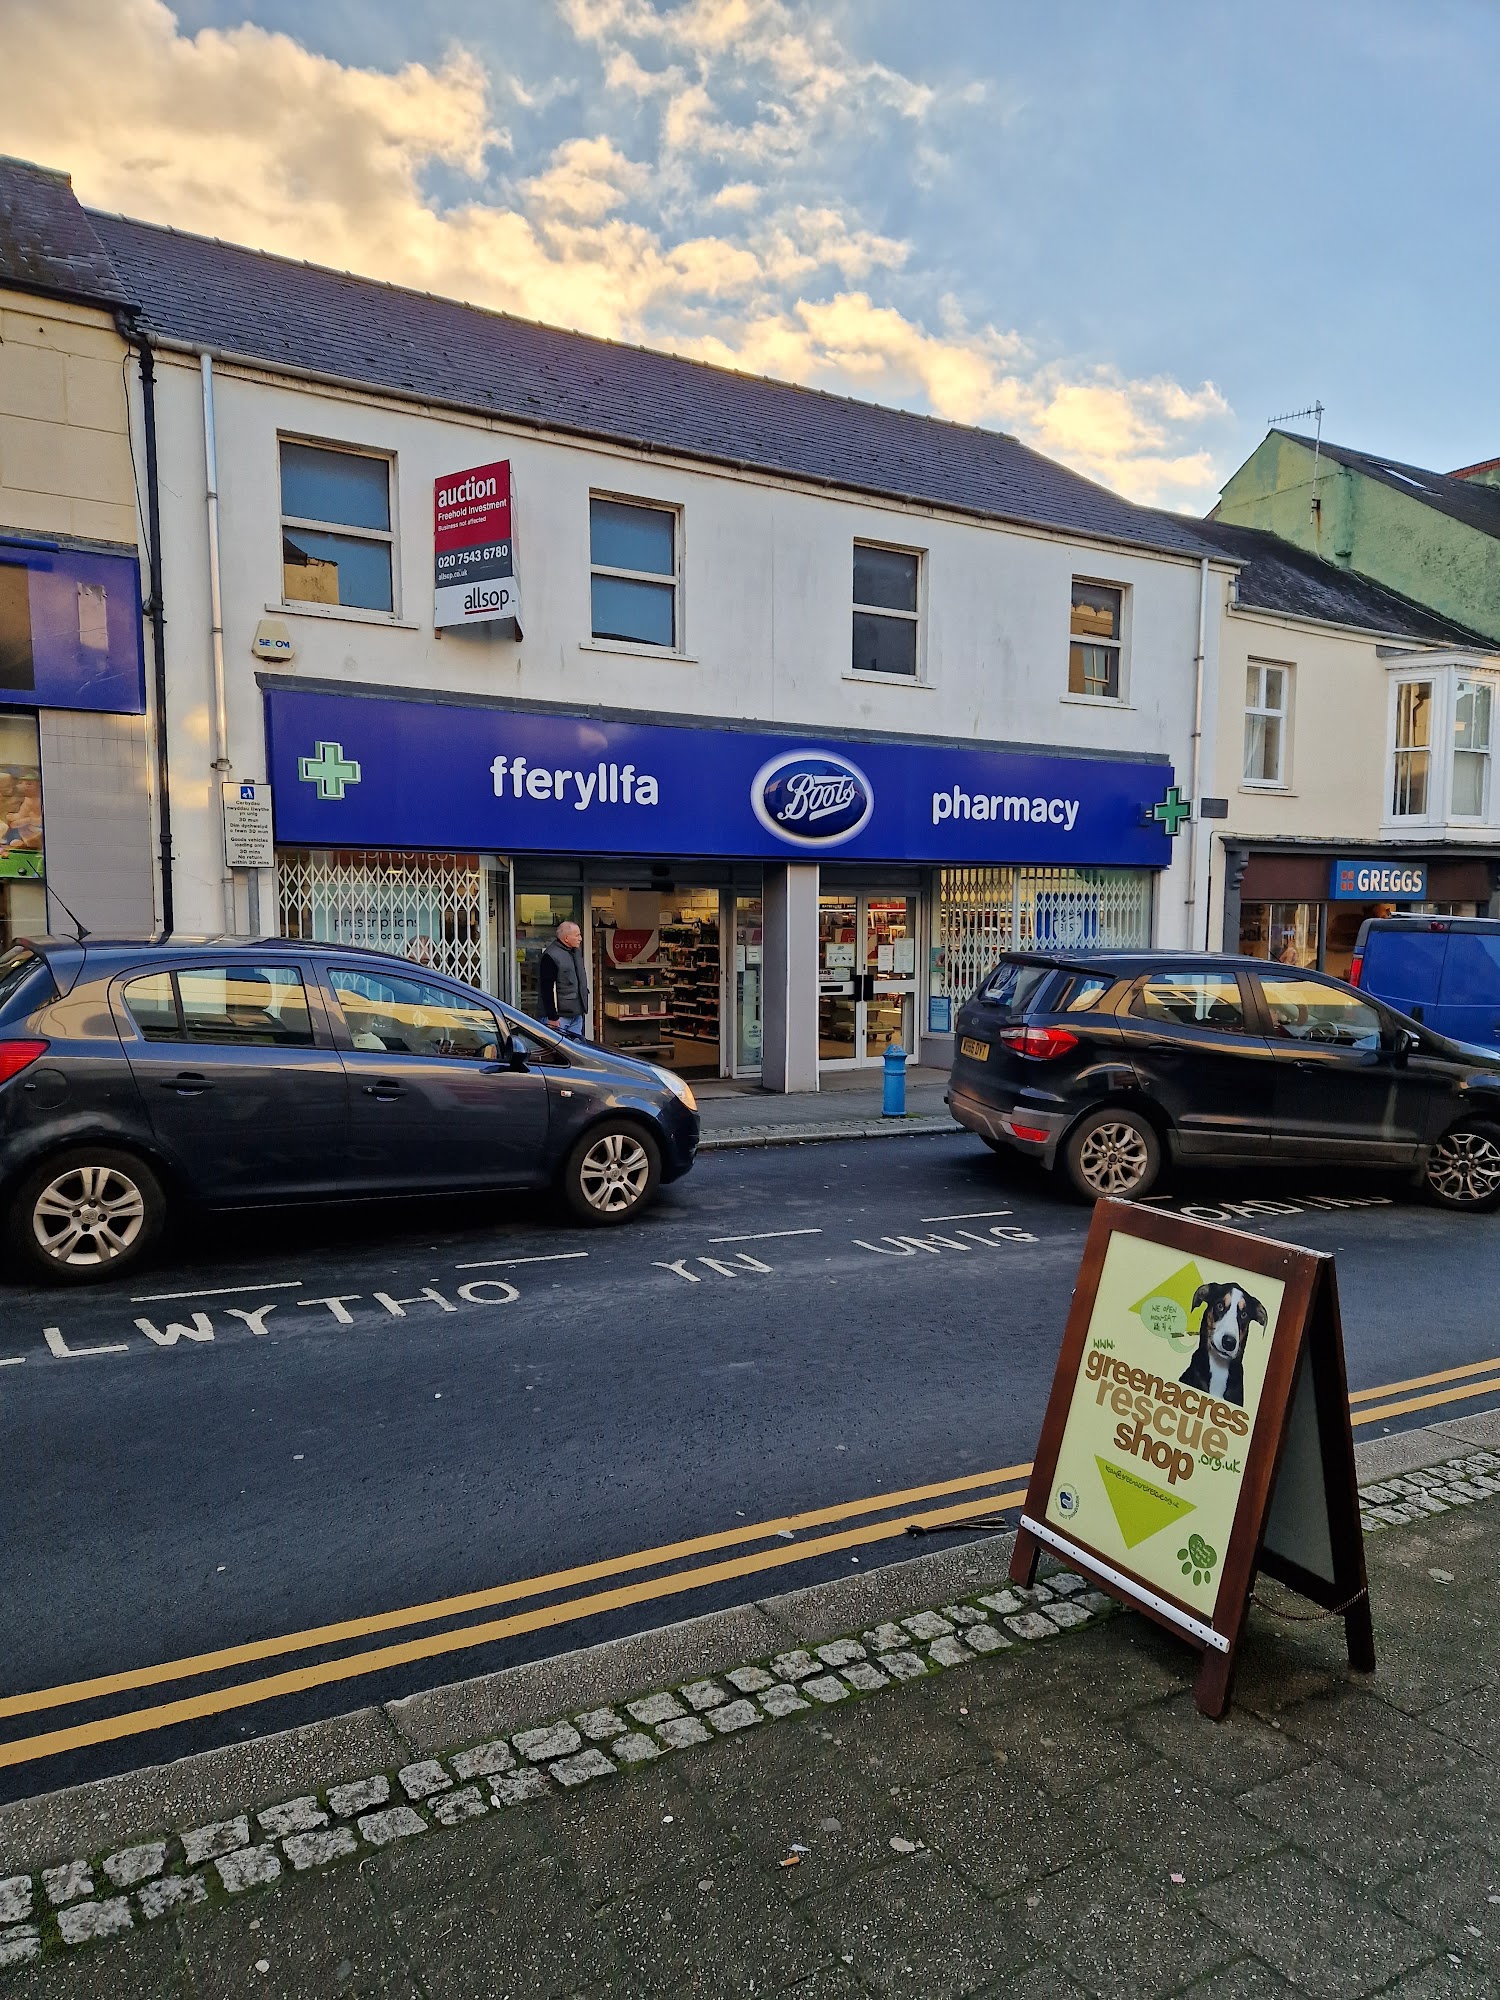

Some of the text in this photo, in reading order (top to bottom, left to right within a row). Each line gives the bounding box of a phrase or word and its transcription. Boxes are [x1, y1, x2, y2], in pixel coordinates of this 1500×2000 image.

[438, 475, 497, 508] auction
[438, 498, 507, 521] Freehold Investment
[438, 522, 459, 532] Business
[467, 516, 487, 526] affected
[438, 545, 508, 568] 020 7543 6780
[464, 587, 510, 610] allsop
[259, 638, 290, 649] SECOM
[490, 755, 659, 811] fferyllfa
[777, 773, 856, 822] Boots
[932, 784, 1080, 831] pharmacy
[1357, 868, 1423, 893] GREGGS
[348, 903, 405, 916] Swtc you
[335, 916, 419, 931] prescrpions
[1180, 1196, 1393, 1221] OADING
[43, 1225, 1040, 1358] LWYTHO YN UNIG
[1151, 1304, 1160, 1313] WE
[1085, 1350, 1249, 1436] greenacres
[1095, 1379, 1228, 1459] rescue
[1113, 1420, 1194, 1485] shop
